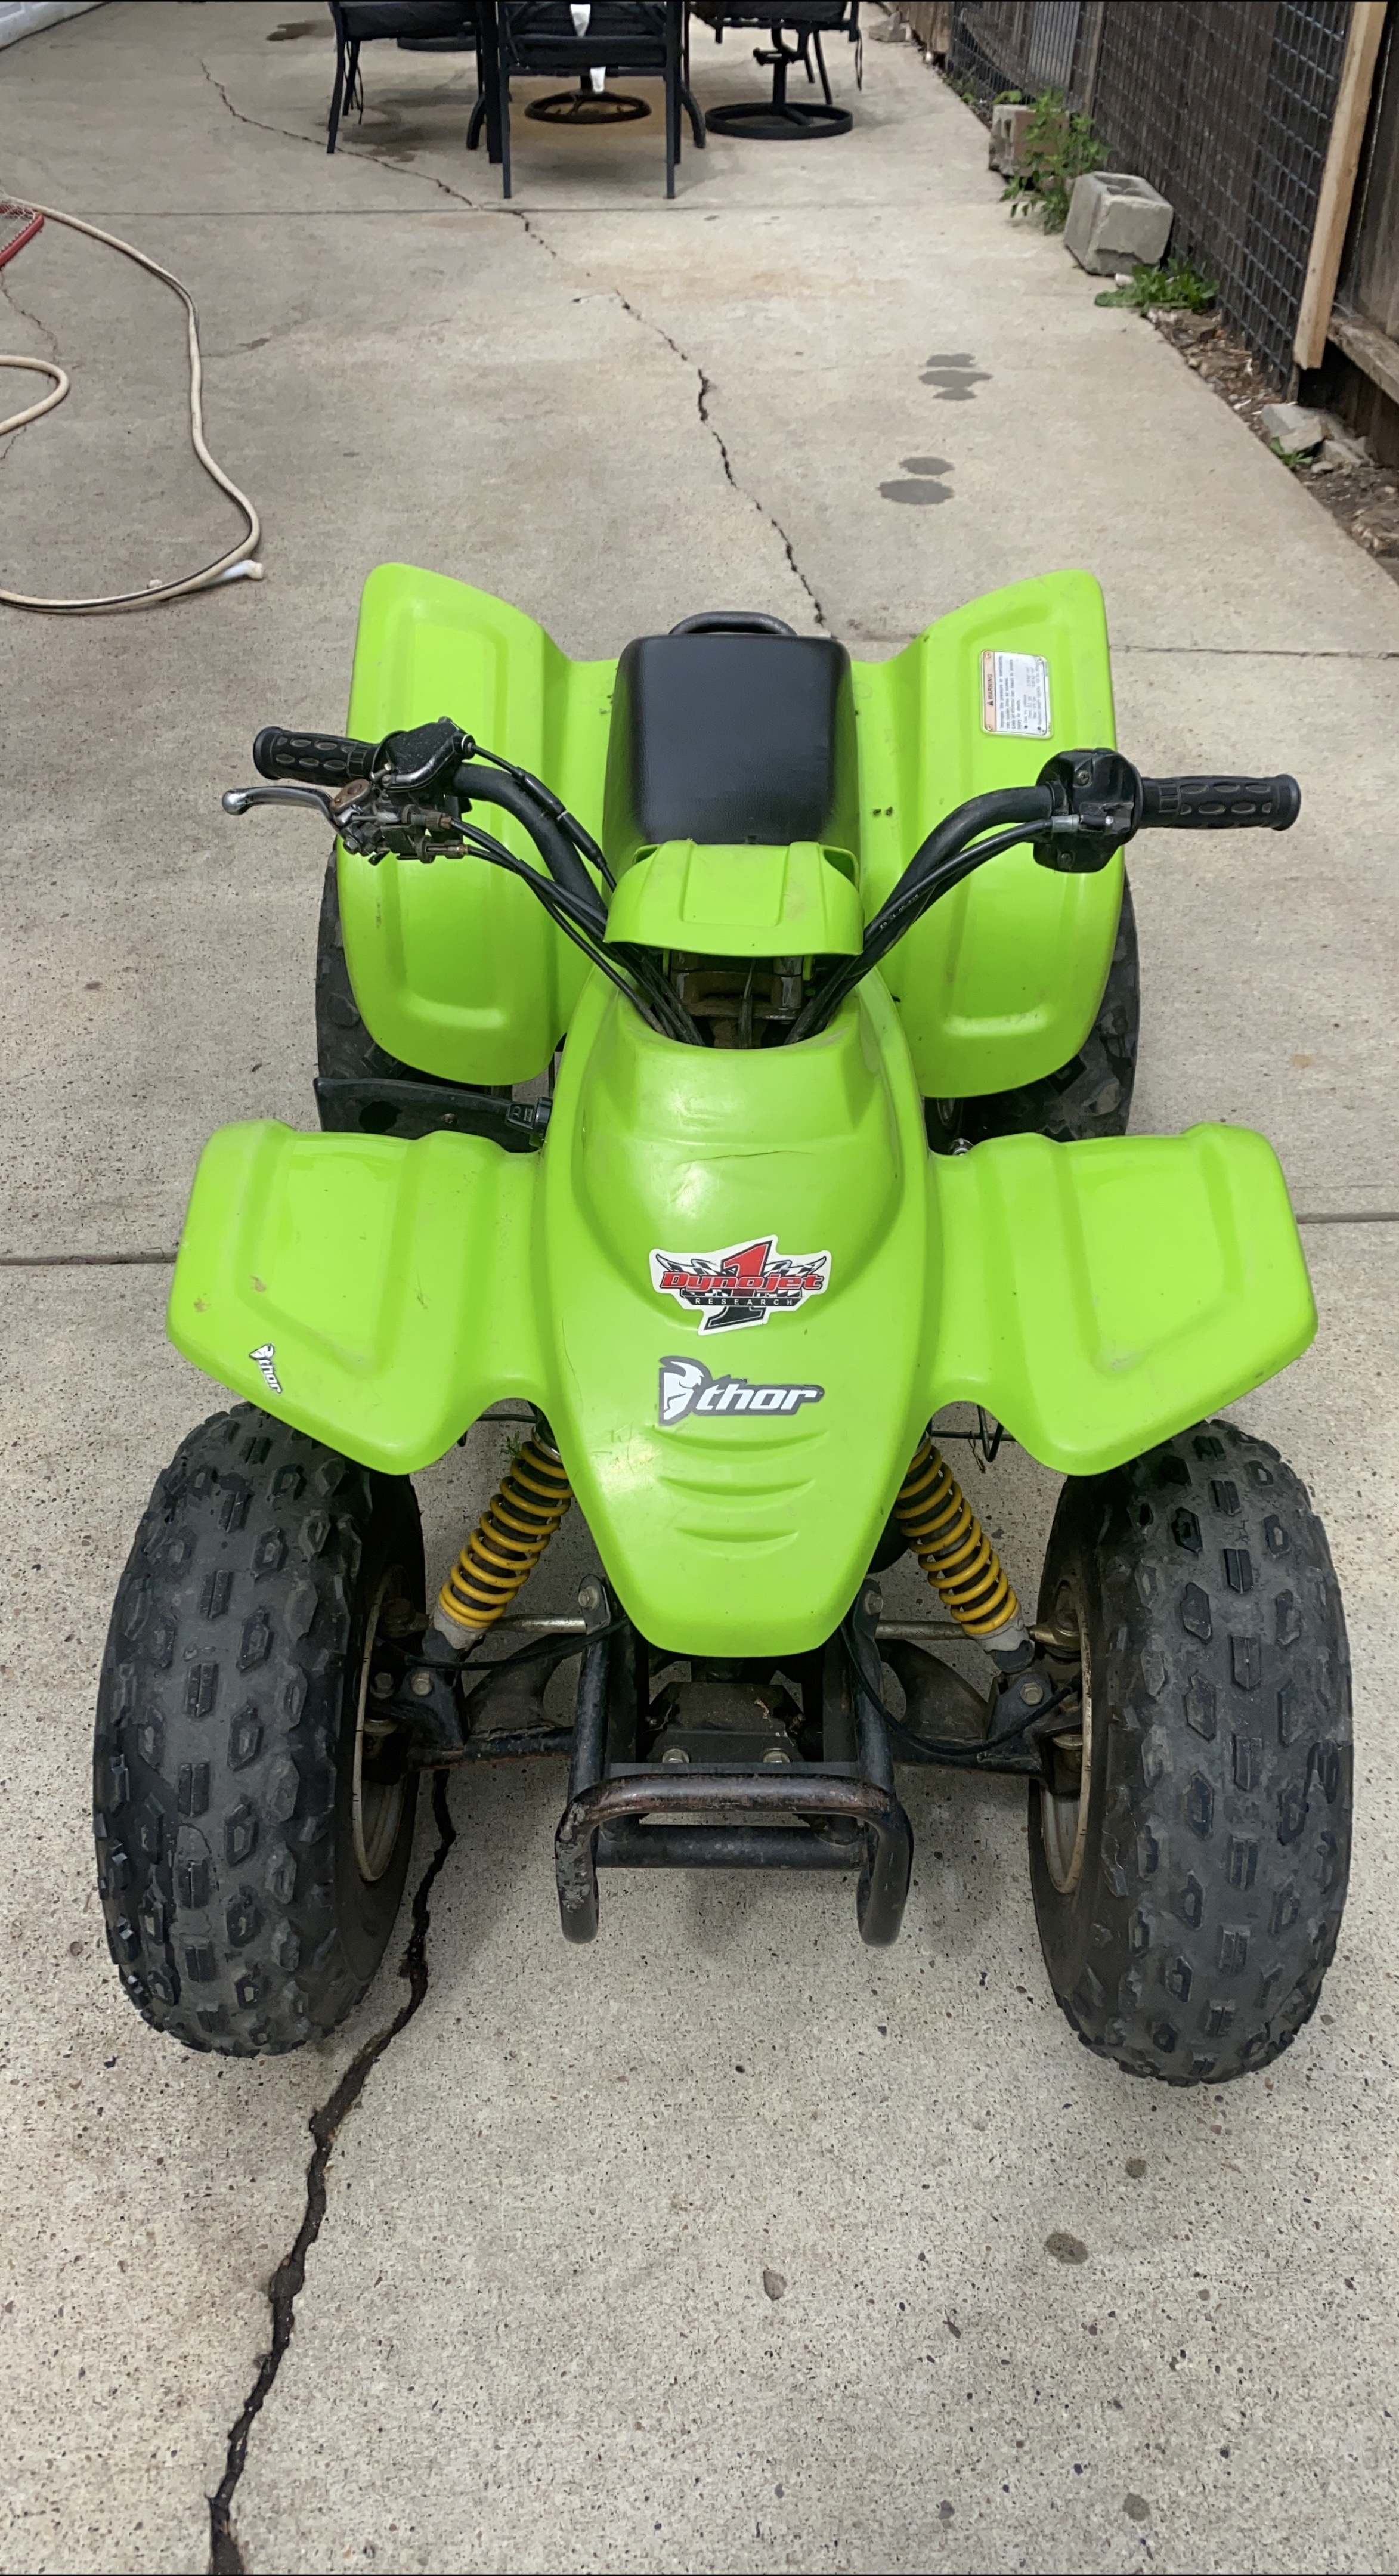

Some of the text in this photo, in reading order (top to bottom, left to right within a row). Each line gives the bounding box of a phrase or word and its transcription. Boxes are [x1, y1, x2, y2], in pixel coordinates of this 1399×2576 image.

[660, 1271, 824, 1292] Dynojet
[695, 1297, 794, 1305] RESEARCH
[259, 1360, 281, 1392] thor
[695, 1383, 818, 1410] thor
